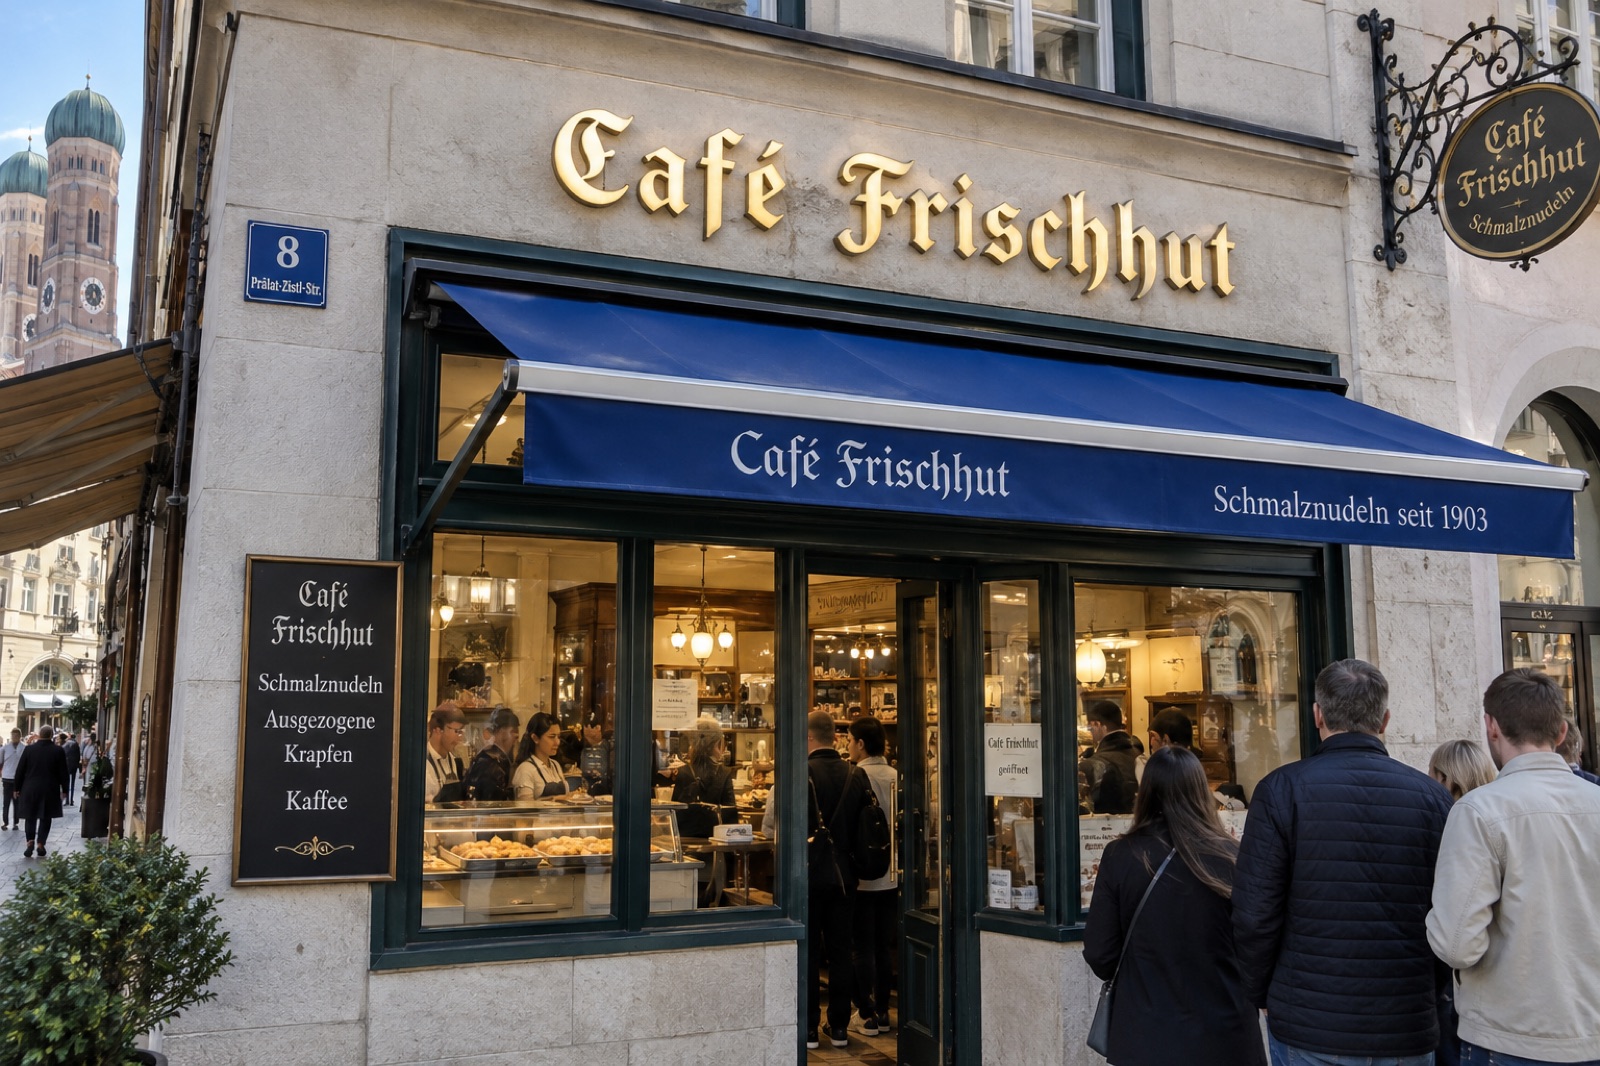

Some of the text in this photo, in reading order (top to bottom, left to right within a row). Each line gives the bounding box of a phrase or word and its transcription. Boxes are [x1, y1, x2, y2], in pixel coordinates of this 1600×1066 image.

[1484, 105, 1546, 154] Café
[1456, 136, 1587, 208] Frischhut
[552, 108, 1237, 300] Café Frischhut
[1468, 185, 1576, 237] Schmalznudeln
[276, 235, 300, 269] 8
[730, 429, 1011, 503] Café Frischhut
[1213, 484, 1489, 533] Schmalznudeln seit 1903
[297, 579, 348, 612] Café
[271, 615, 374, 650] Frischhut
[258, 672, 384, 696] Schmalznudeln
[264, 709, 376, 733] Ausgezogene
[283, 743, 353, 768] Krapfen
[285, 789, 349, 812] Kaffee
